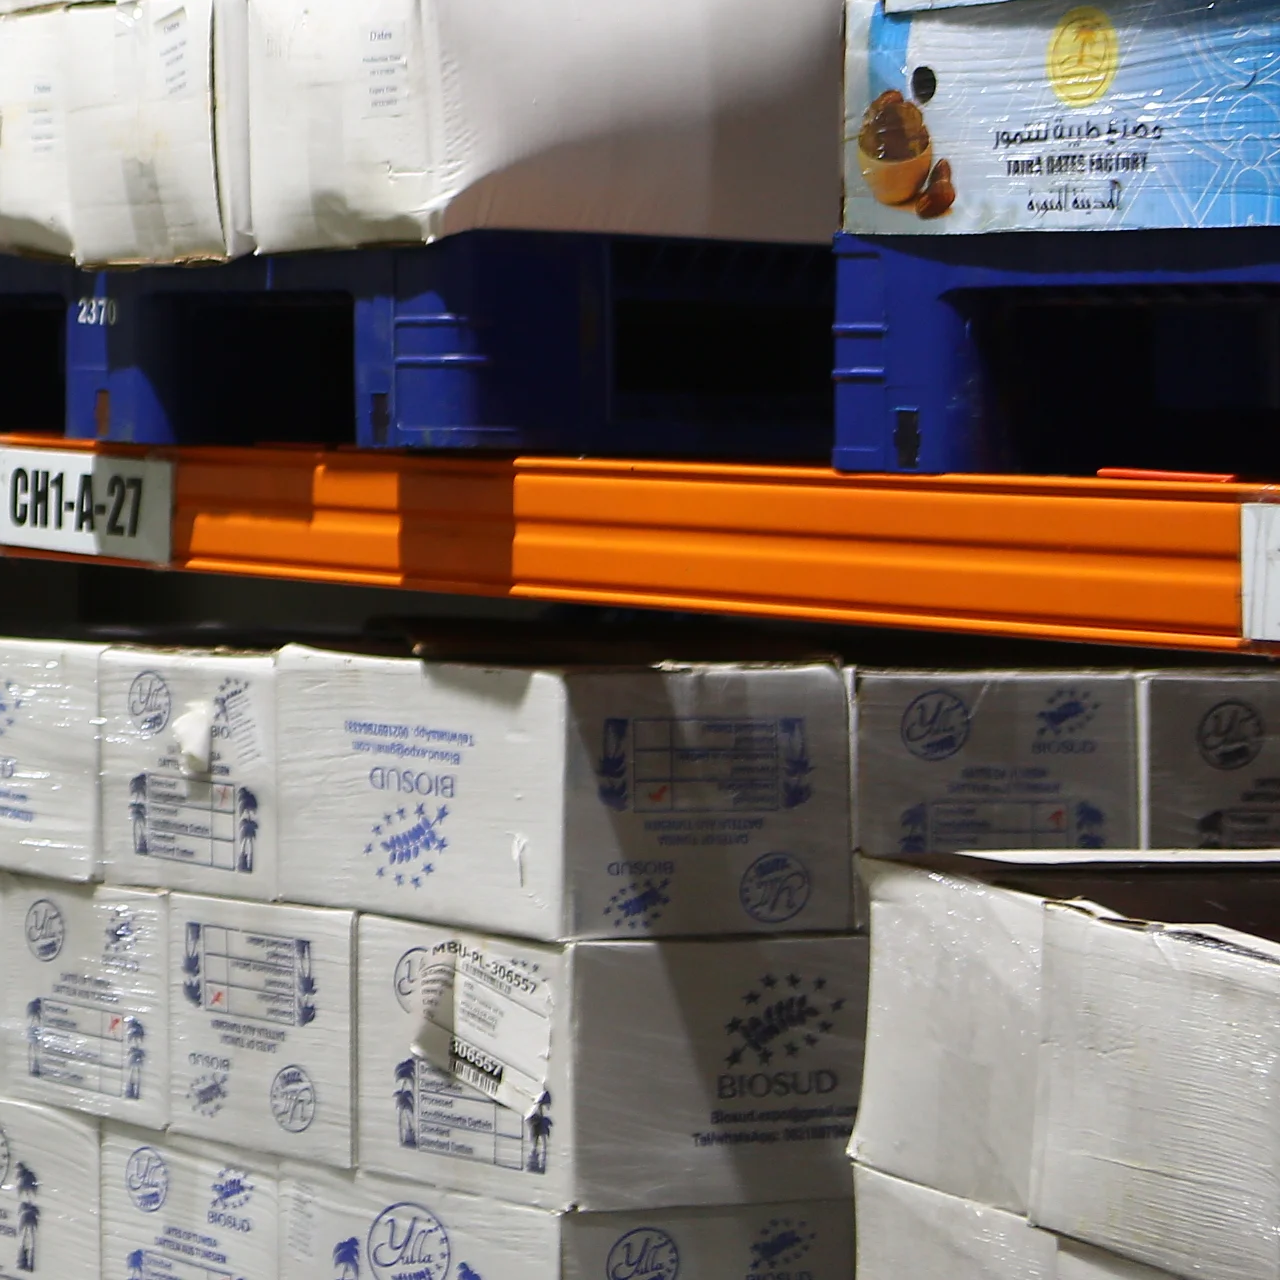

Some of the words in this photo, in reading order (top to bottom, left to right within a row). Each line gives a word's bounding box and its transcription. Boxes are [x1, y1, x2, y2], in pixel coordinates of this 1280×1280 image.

[369, 30, 392, 41] Dates
[77, 298, 117, 325] 2370
[9, 467, 144, 538] CH1-A-27
[368, 768, 455, 799] BIOSUD
[606, 861, 675, 876] BIOSUD
[432, 939, 537, 995] MBU-PL-306557
[188, 1052, 231, 1073] BIOSUD
[717, 1070, 838, 1099] BIOSUD
[207, 1211, 251, 1233] BIOSUD
